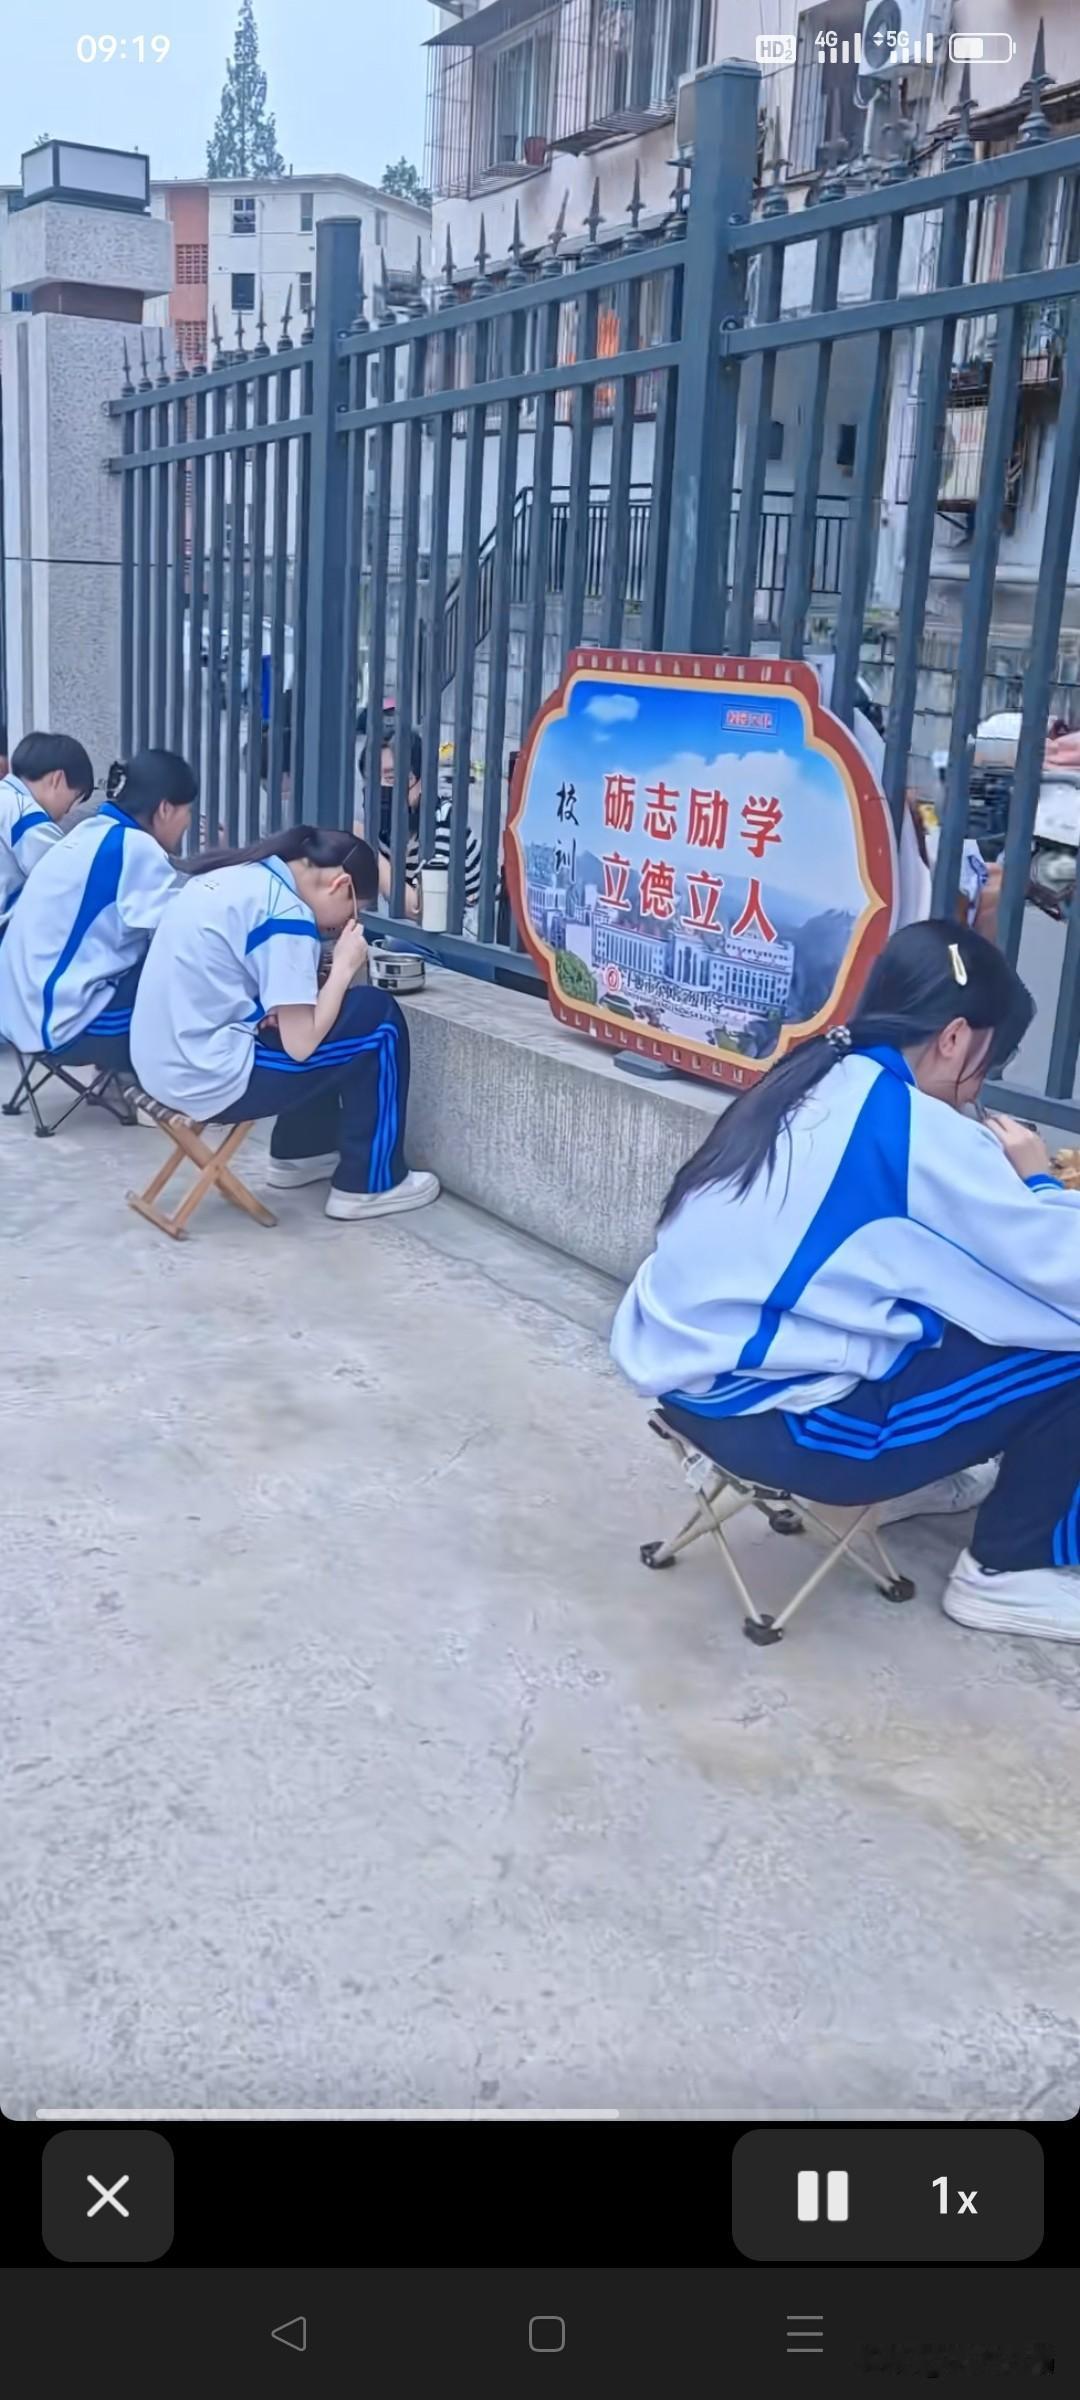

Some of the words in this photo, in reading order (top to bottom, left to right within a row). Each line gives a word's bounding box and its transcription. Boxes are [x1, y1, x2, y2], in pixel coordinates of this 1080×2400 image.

[555, 780, 580, 884] 校训
[602, 772, 785, 859] 砺志励学
[597, 851, 778, 943] 立德立人
